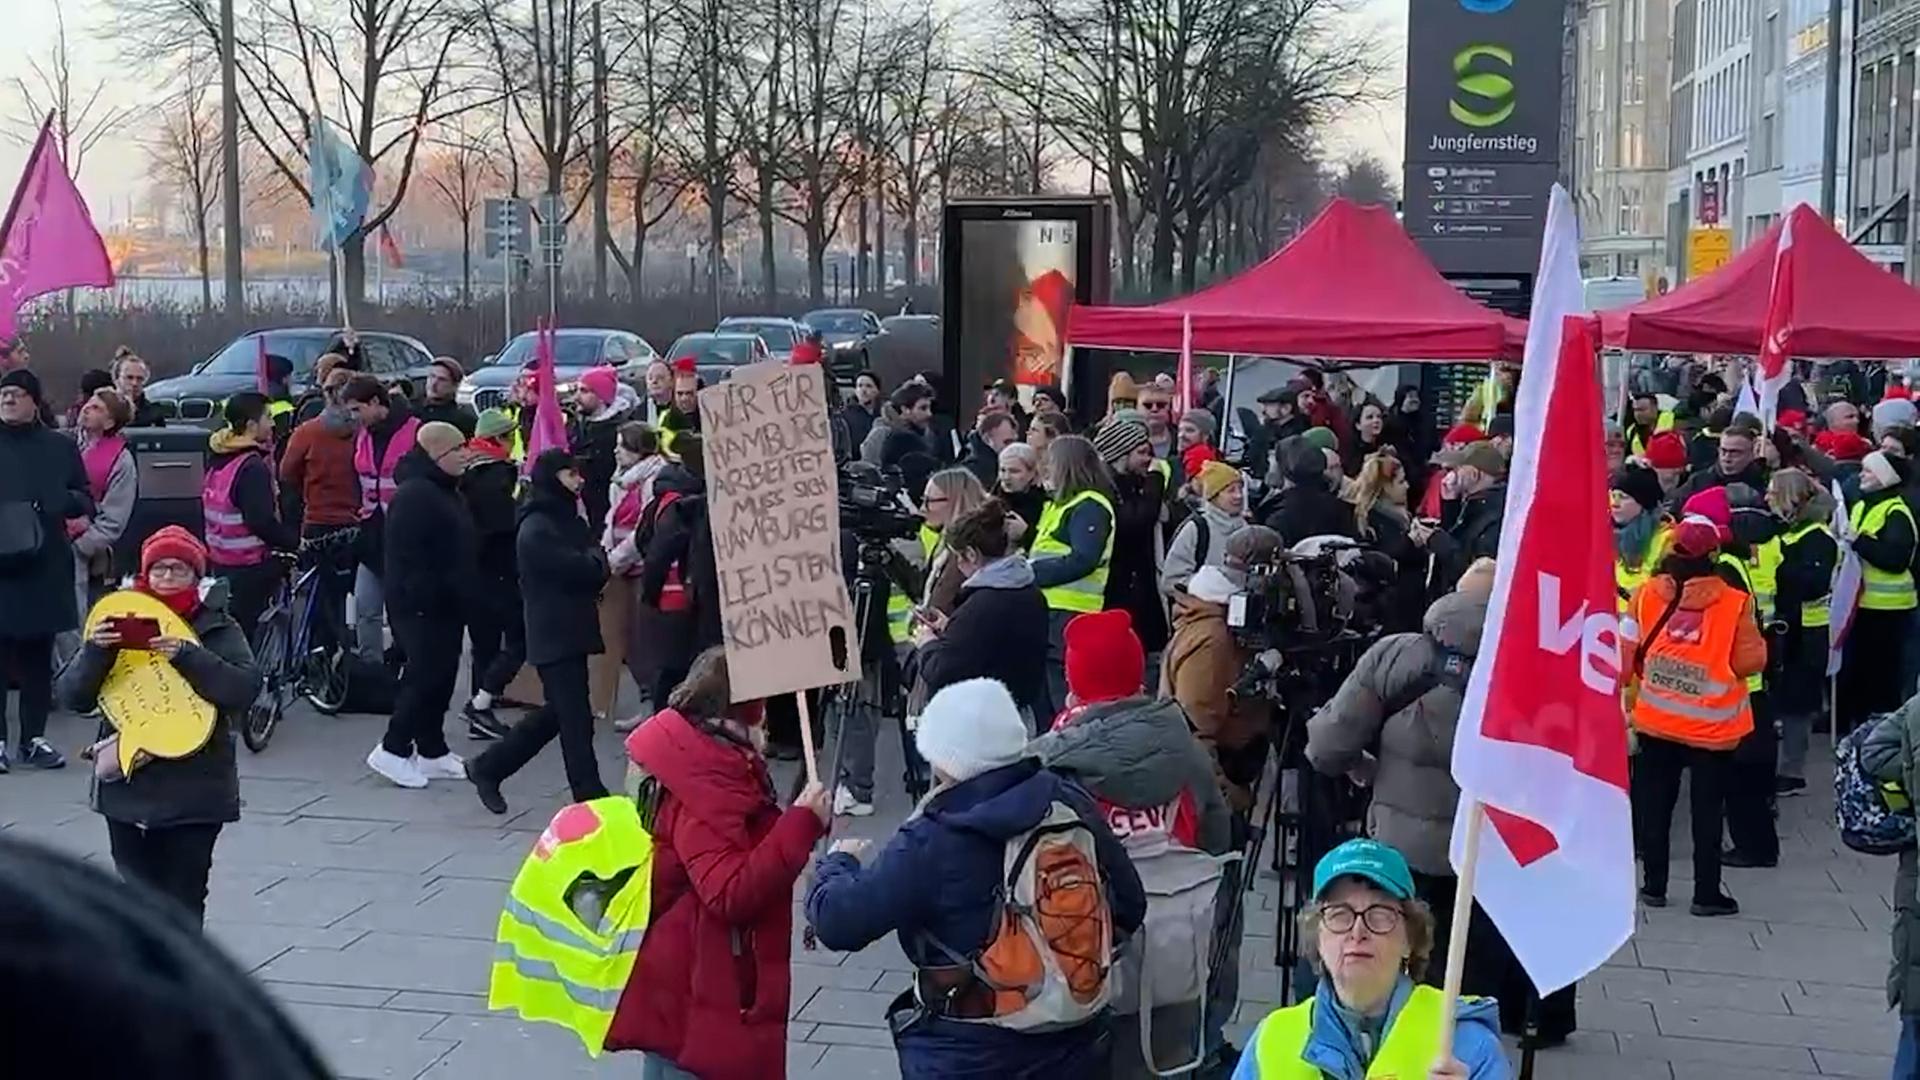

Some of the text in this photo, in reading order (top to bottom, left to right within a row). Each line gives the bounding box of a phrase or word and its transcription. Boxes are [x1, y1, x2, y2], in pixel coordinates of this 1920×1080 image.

[1428, 133, 1537, 154] Jungfernstieg
[703, 372, 822, 435] WER FÜR
[708, 412, 828, 470] HAMBURG
[712, 450, 829, 502] ARBEITET
[730, 479, 829, 524] MUSS SICH
[716, 504, 829, 562] HAMBURG
[719, 543, 838, 608] LEISTEN
[726, 587, 849, 652] KÖNNEN
